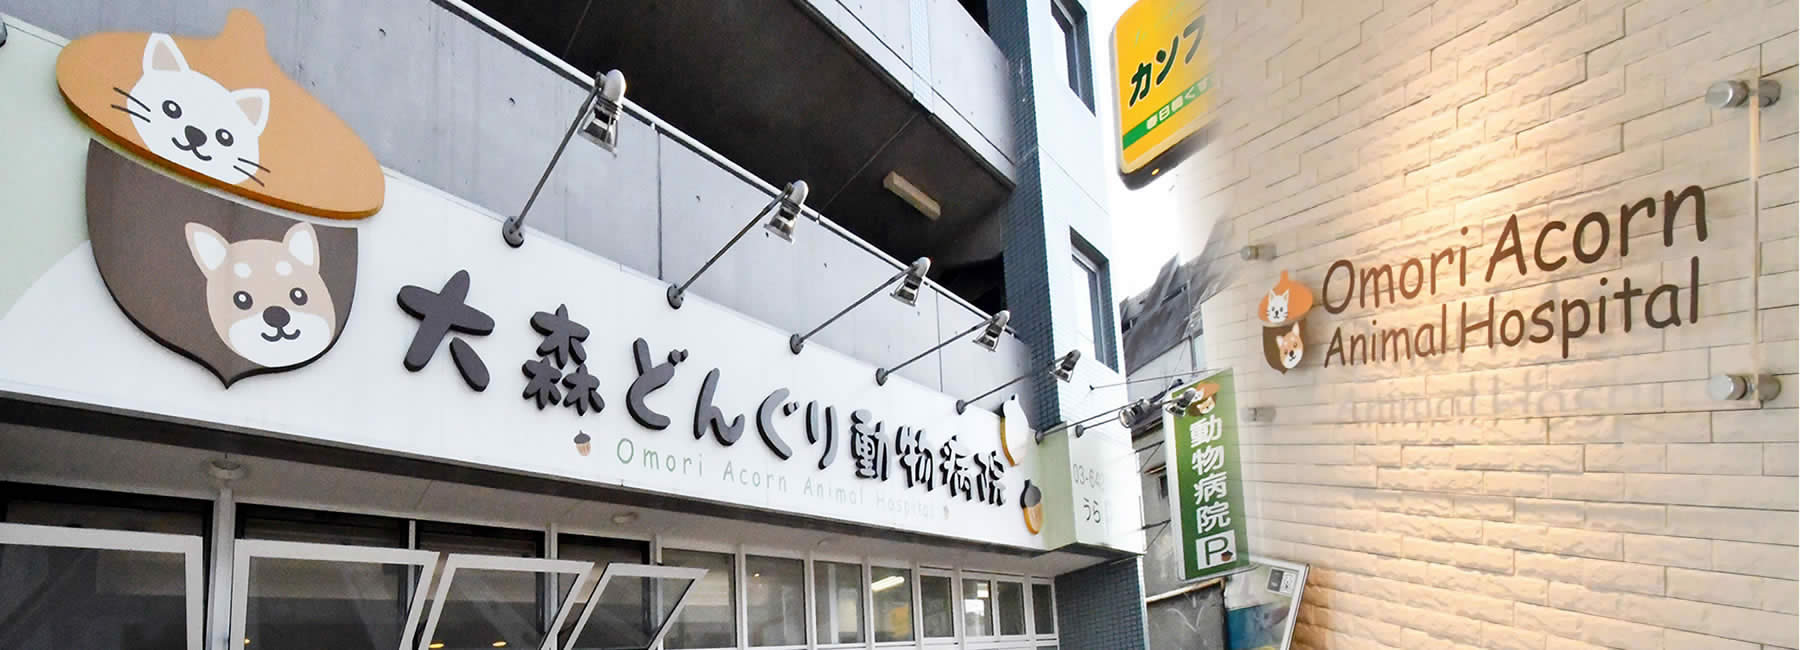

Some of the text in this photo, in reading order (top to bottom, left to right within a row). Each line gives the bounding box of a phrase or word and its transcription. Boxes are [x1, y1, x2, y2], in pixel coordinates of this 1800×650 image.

[1322, 183, 1708, 315] Omori Acorn
[1323, 254, 1700, 369] Animal Hospital
[396, 269, 1007, 507] 大森どんぐり動物病院
[616, 437, 704, 478] Omori
[723, 460, 788, 493] Acorn
[803, 476, 865, 505] Animal
[1189, 413, 1232, 534] 動物病院
